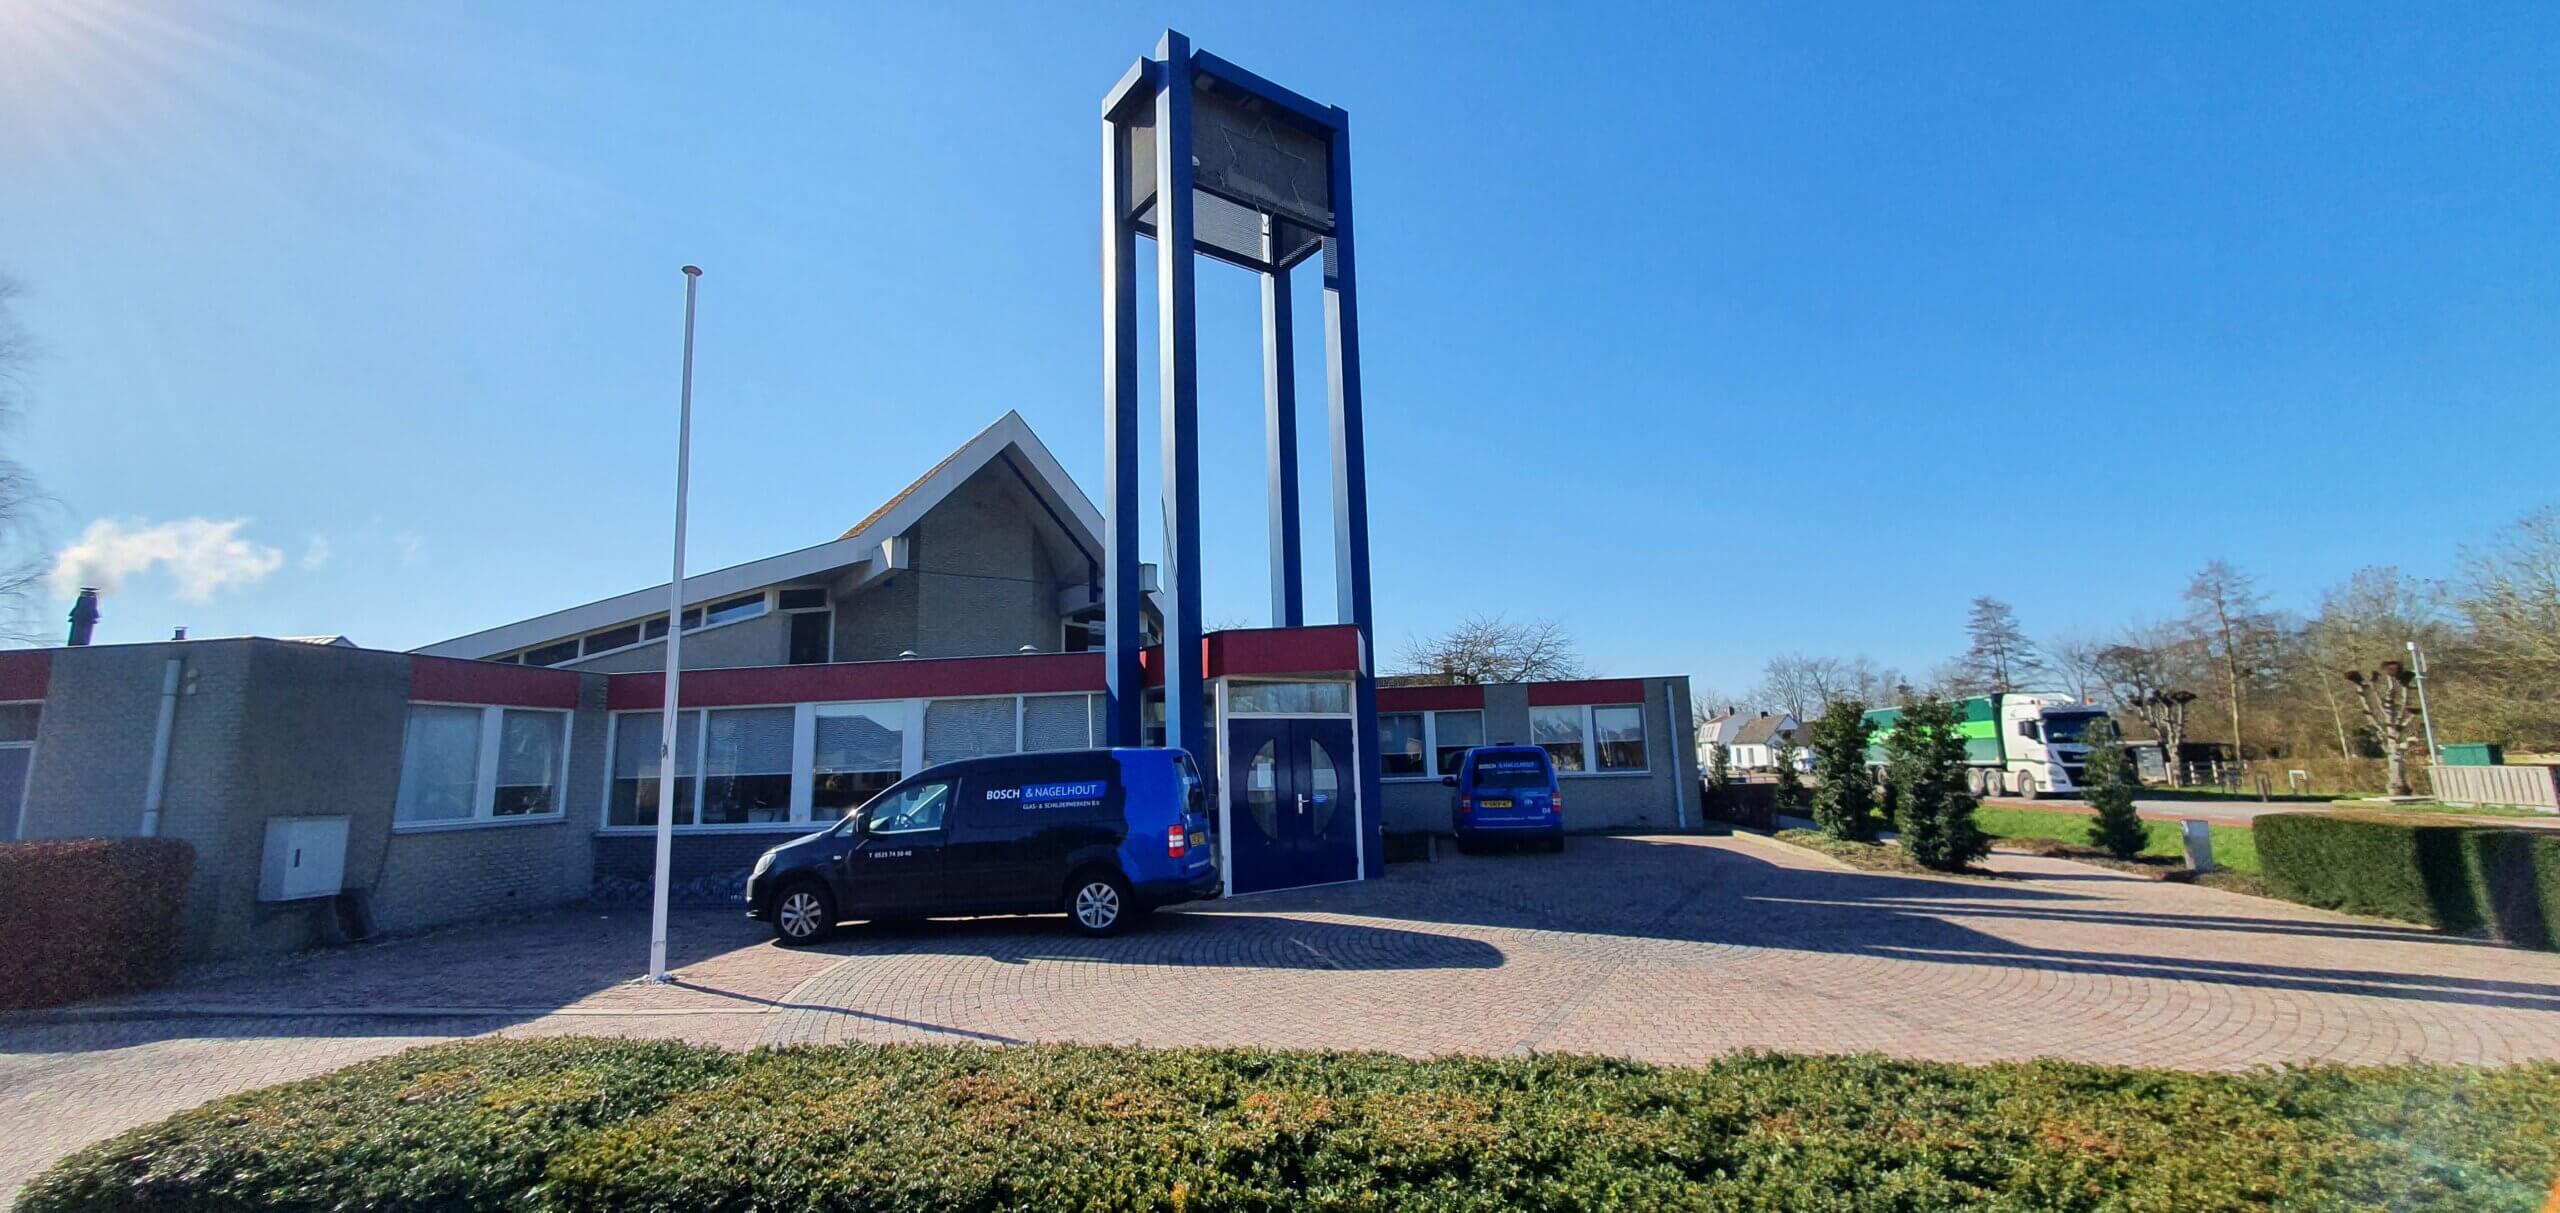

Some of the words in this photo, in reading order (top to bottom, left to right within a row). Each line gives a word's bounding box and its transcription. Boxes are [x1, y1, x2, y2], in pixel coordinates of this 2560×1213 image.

[986, 789, 1020, 800] BOSCH
[1025, 787, 1033, 798] &
[1034, 785, 1097, 797] NAGELHOUT
